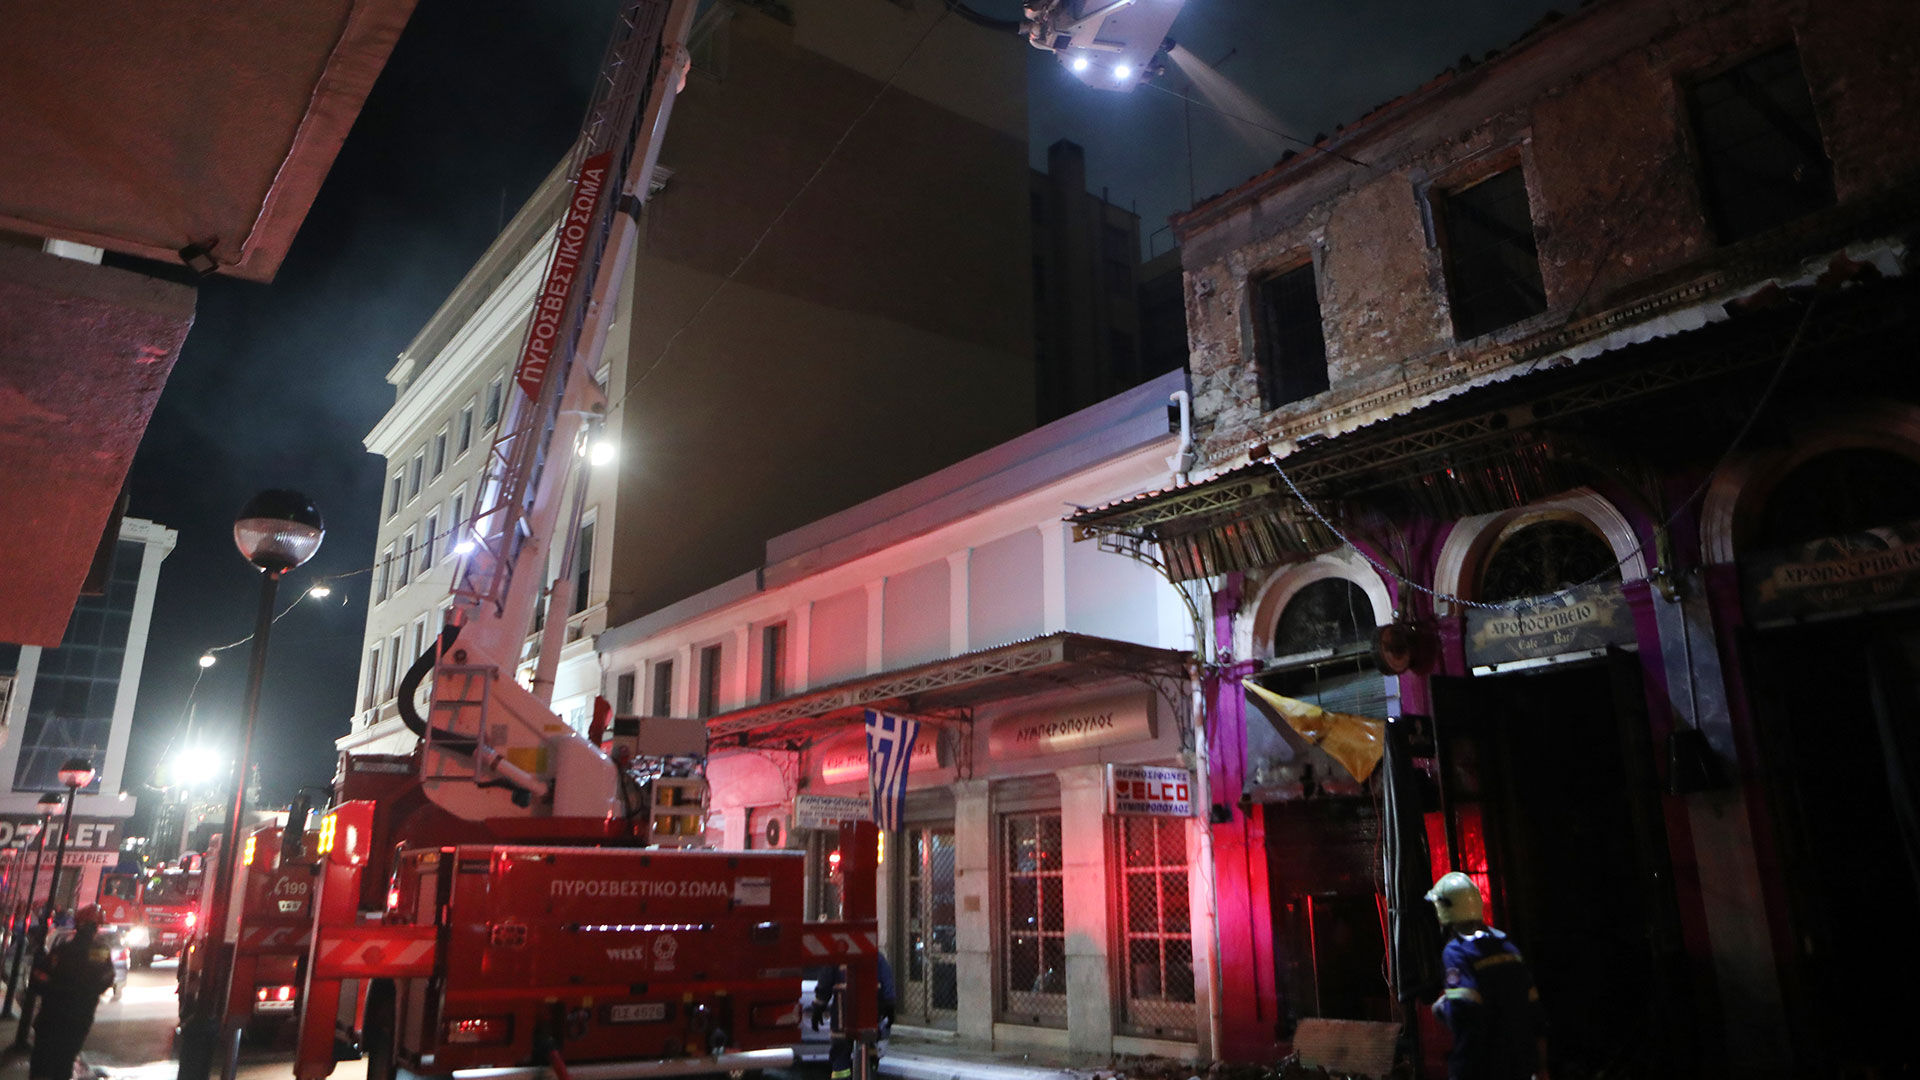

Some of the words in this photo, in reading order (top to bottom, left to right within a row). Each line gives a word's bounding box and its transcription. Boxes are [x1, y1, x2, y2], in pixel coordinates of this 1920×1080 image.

[522, 223, 585, 384] ΠΥΡΟΣΒΕΣΤΙΚΟ
[571, 167, 604, 225] ΣΩΜΑ
[1016, 711, 1114, 742] ΛΥΜΠΕΡΟΠΟΥΛΟΣ
[1131, 781, 1189, 801] ELCO
[283, 881, 308, 895] 199
[550, 879, 677, 897] ΠΥΡΟΣΒΕΣΤΙΚΟ
[678, 880, 729, 897] ΣΩΜΑ
